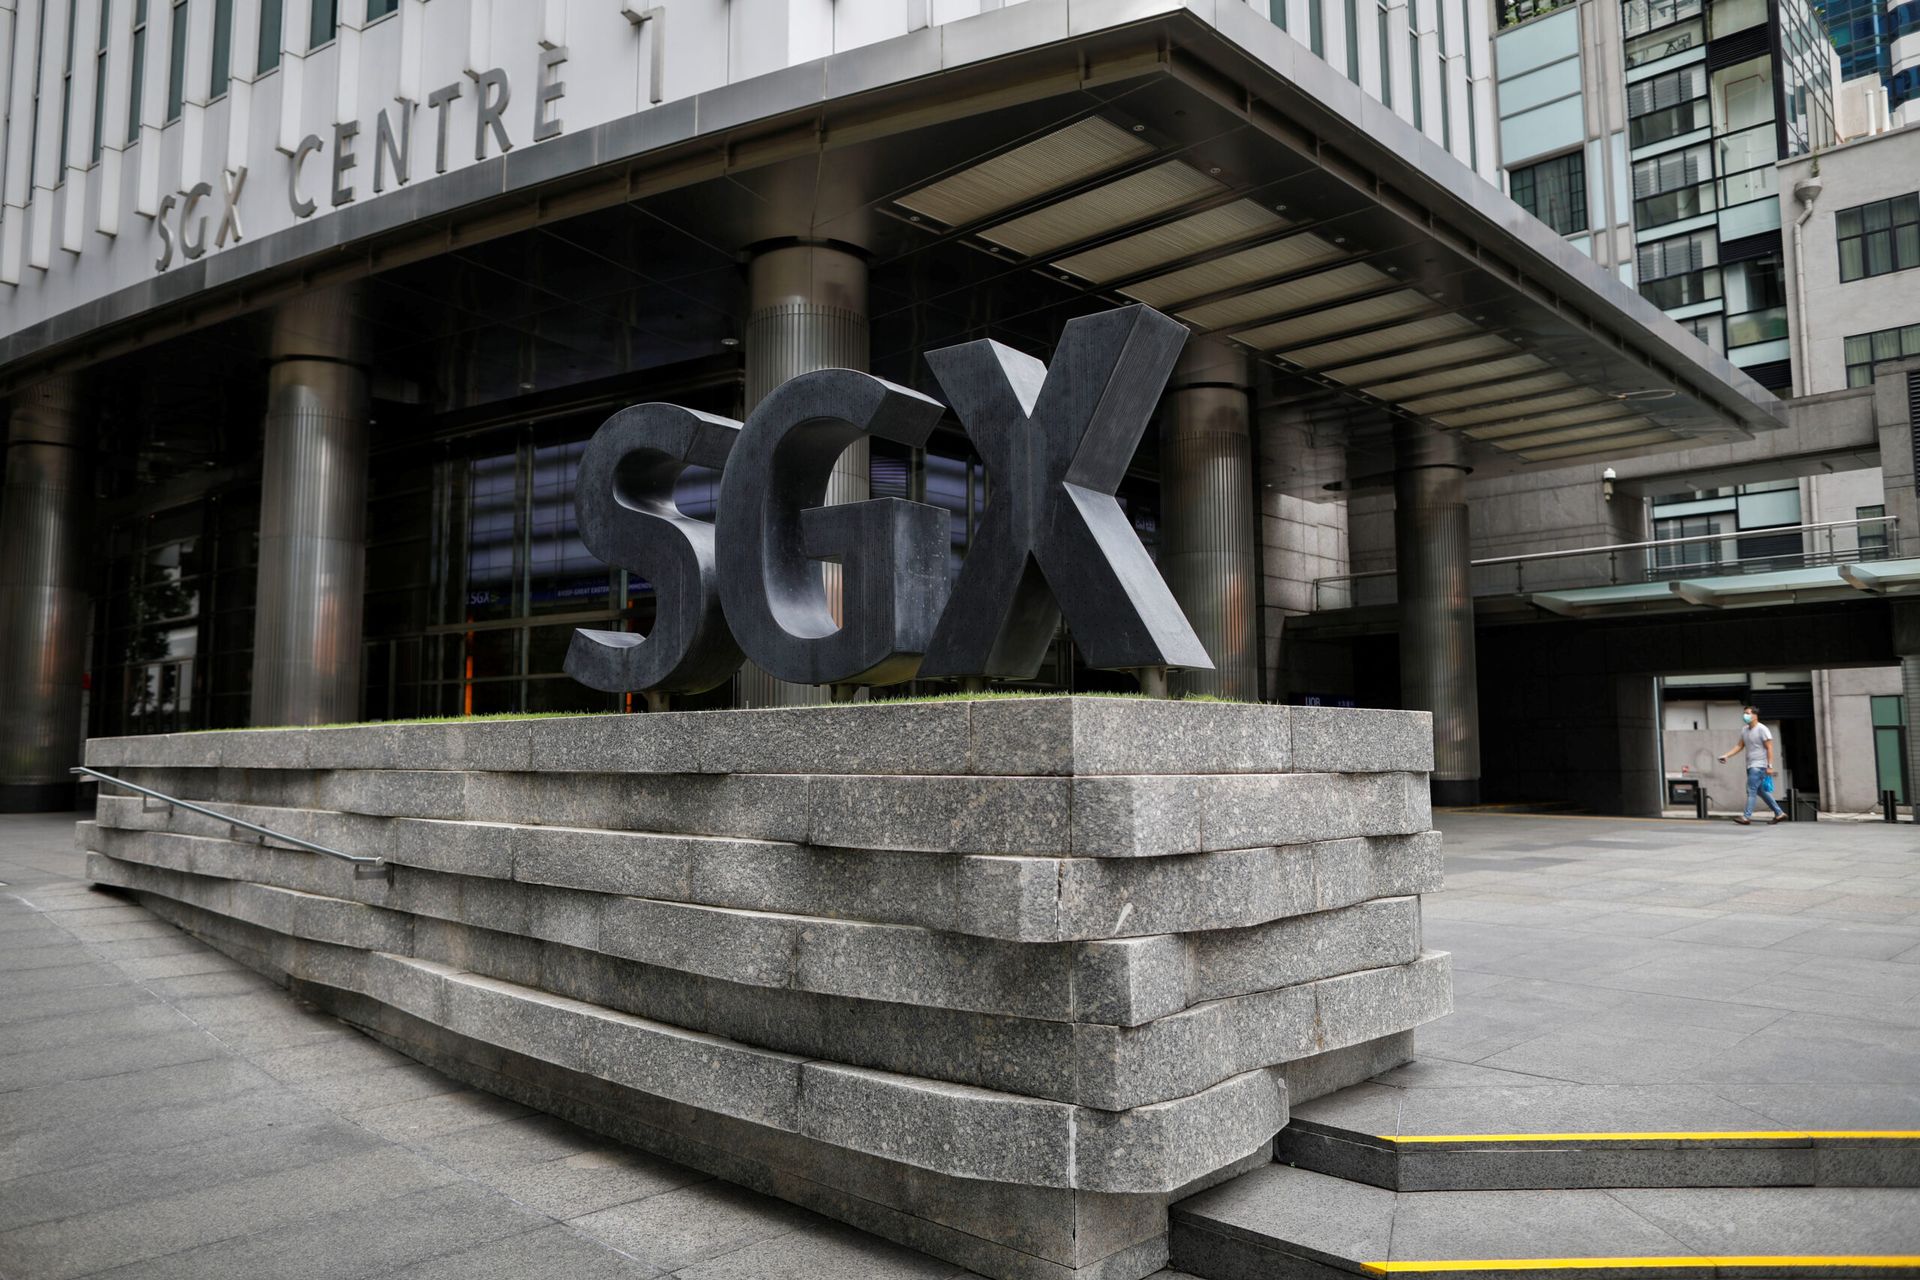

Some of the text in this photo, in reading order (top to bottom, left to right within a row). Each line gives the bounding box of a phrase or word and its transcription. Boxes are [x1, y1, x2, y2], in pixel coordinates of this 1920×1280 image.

[155, 166, 248, 272] SGX
[289, 47, 568, 219] CENTRE
[563, 303, 1215, 694] SGX
